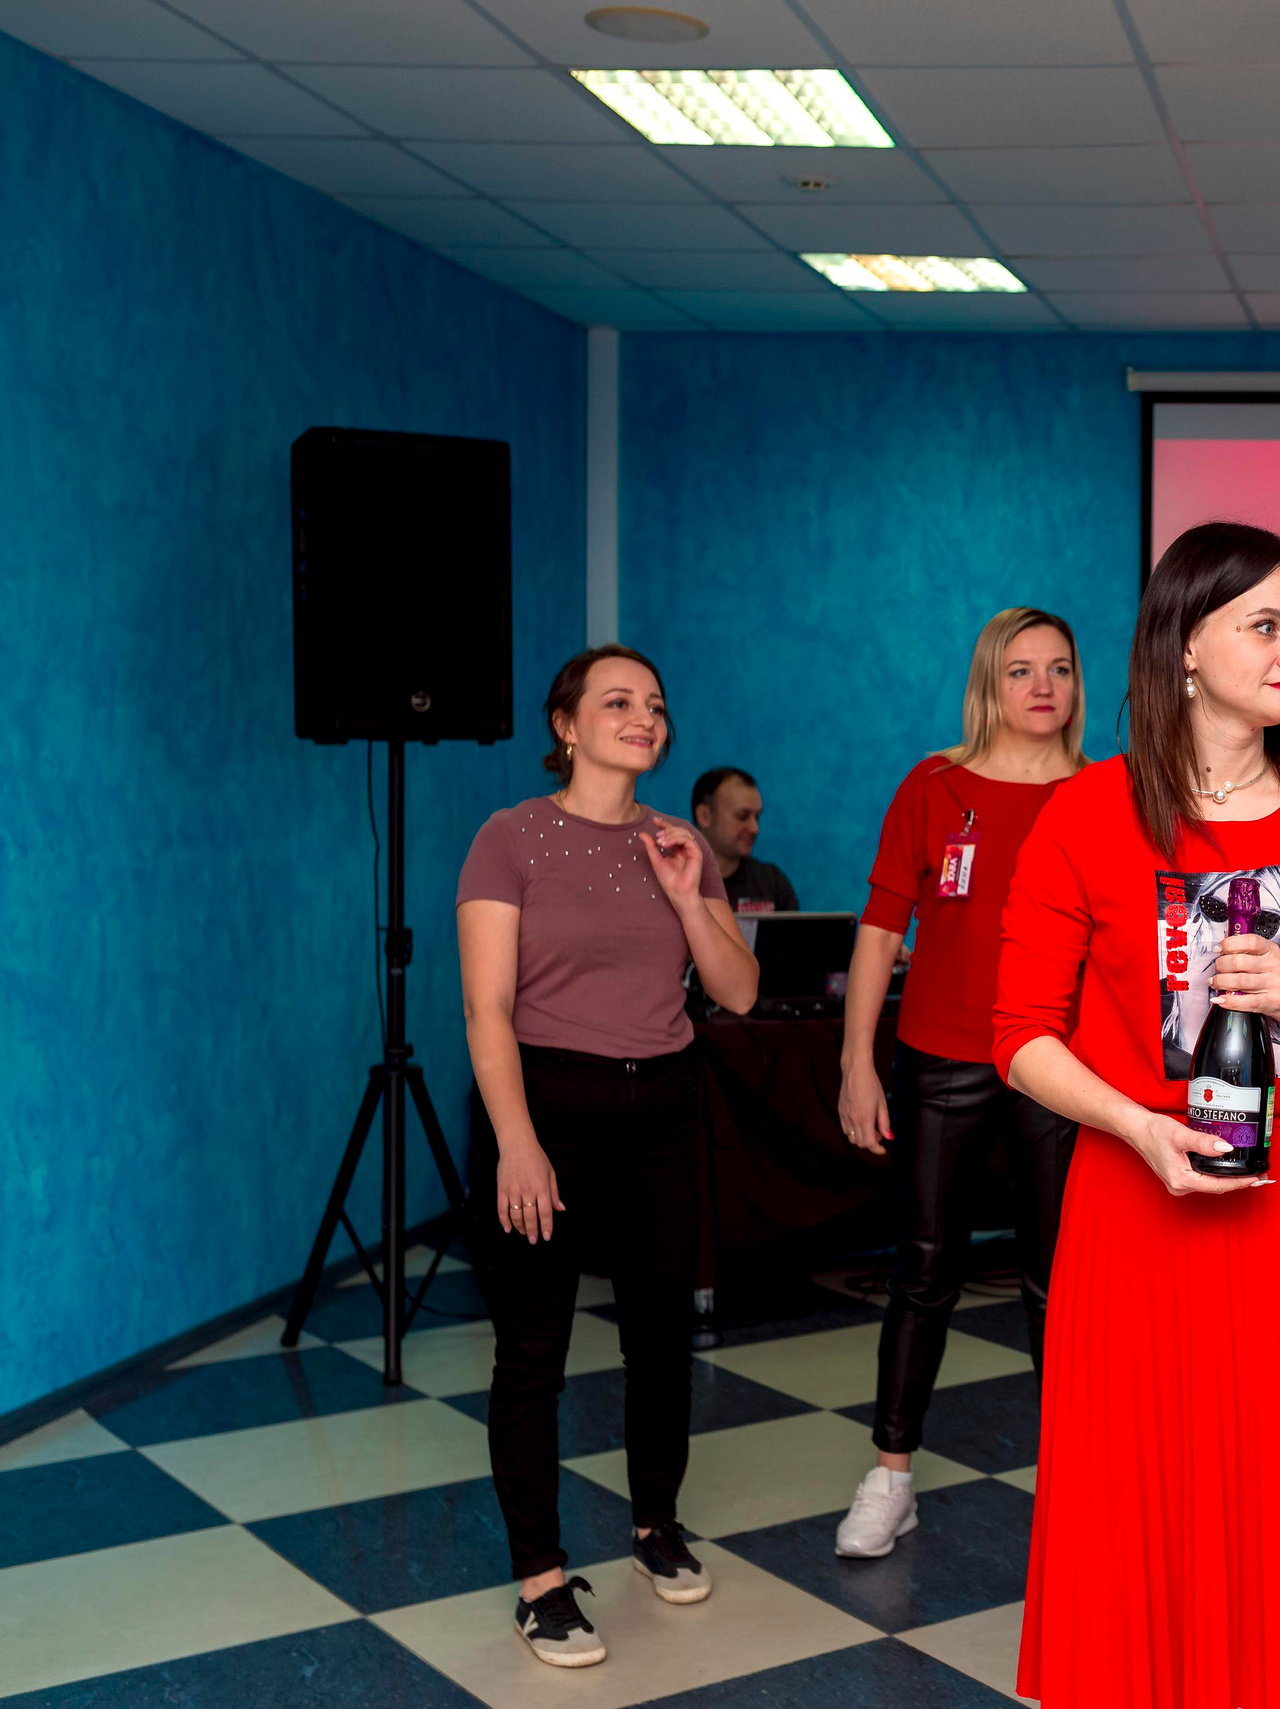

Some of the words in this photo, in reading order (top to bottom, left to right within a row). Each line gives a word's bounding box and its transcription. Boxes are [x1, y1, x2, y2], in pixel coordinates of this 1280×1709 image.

[1160, 876, 1189, 992] reveal
[1188, 1107, 1201, 1118] NTO
[1203, 1109, 1247, 1122] STEFANO
